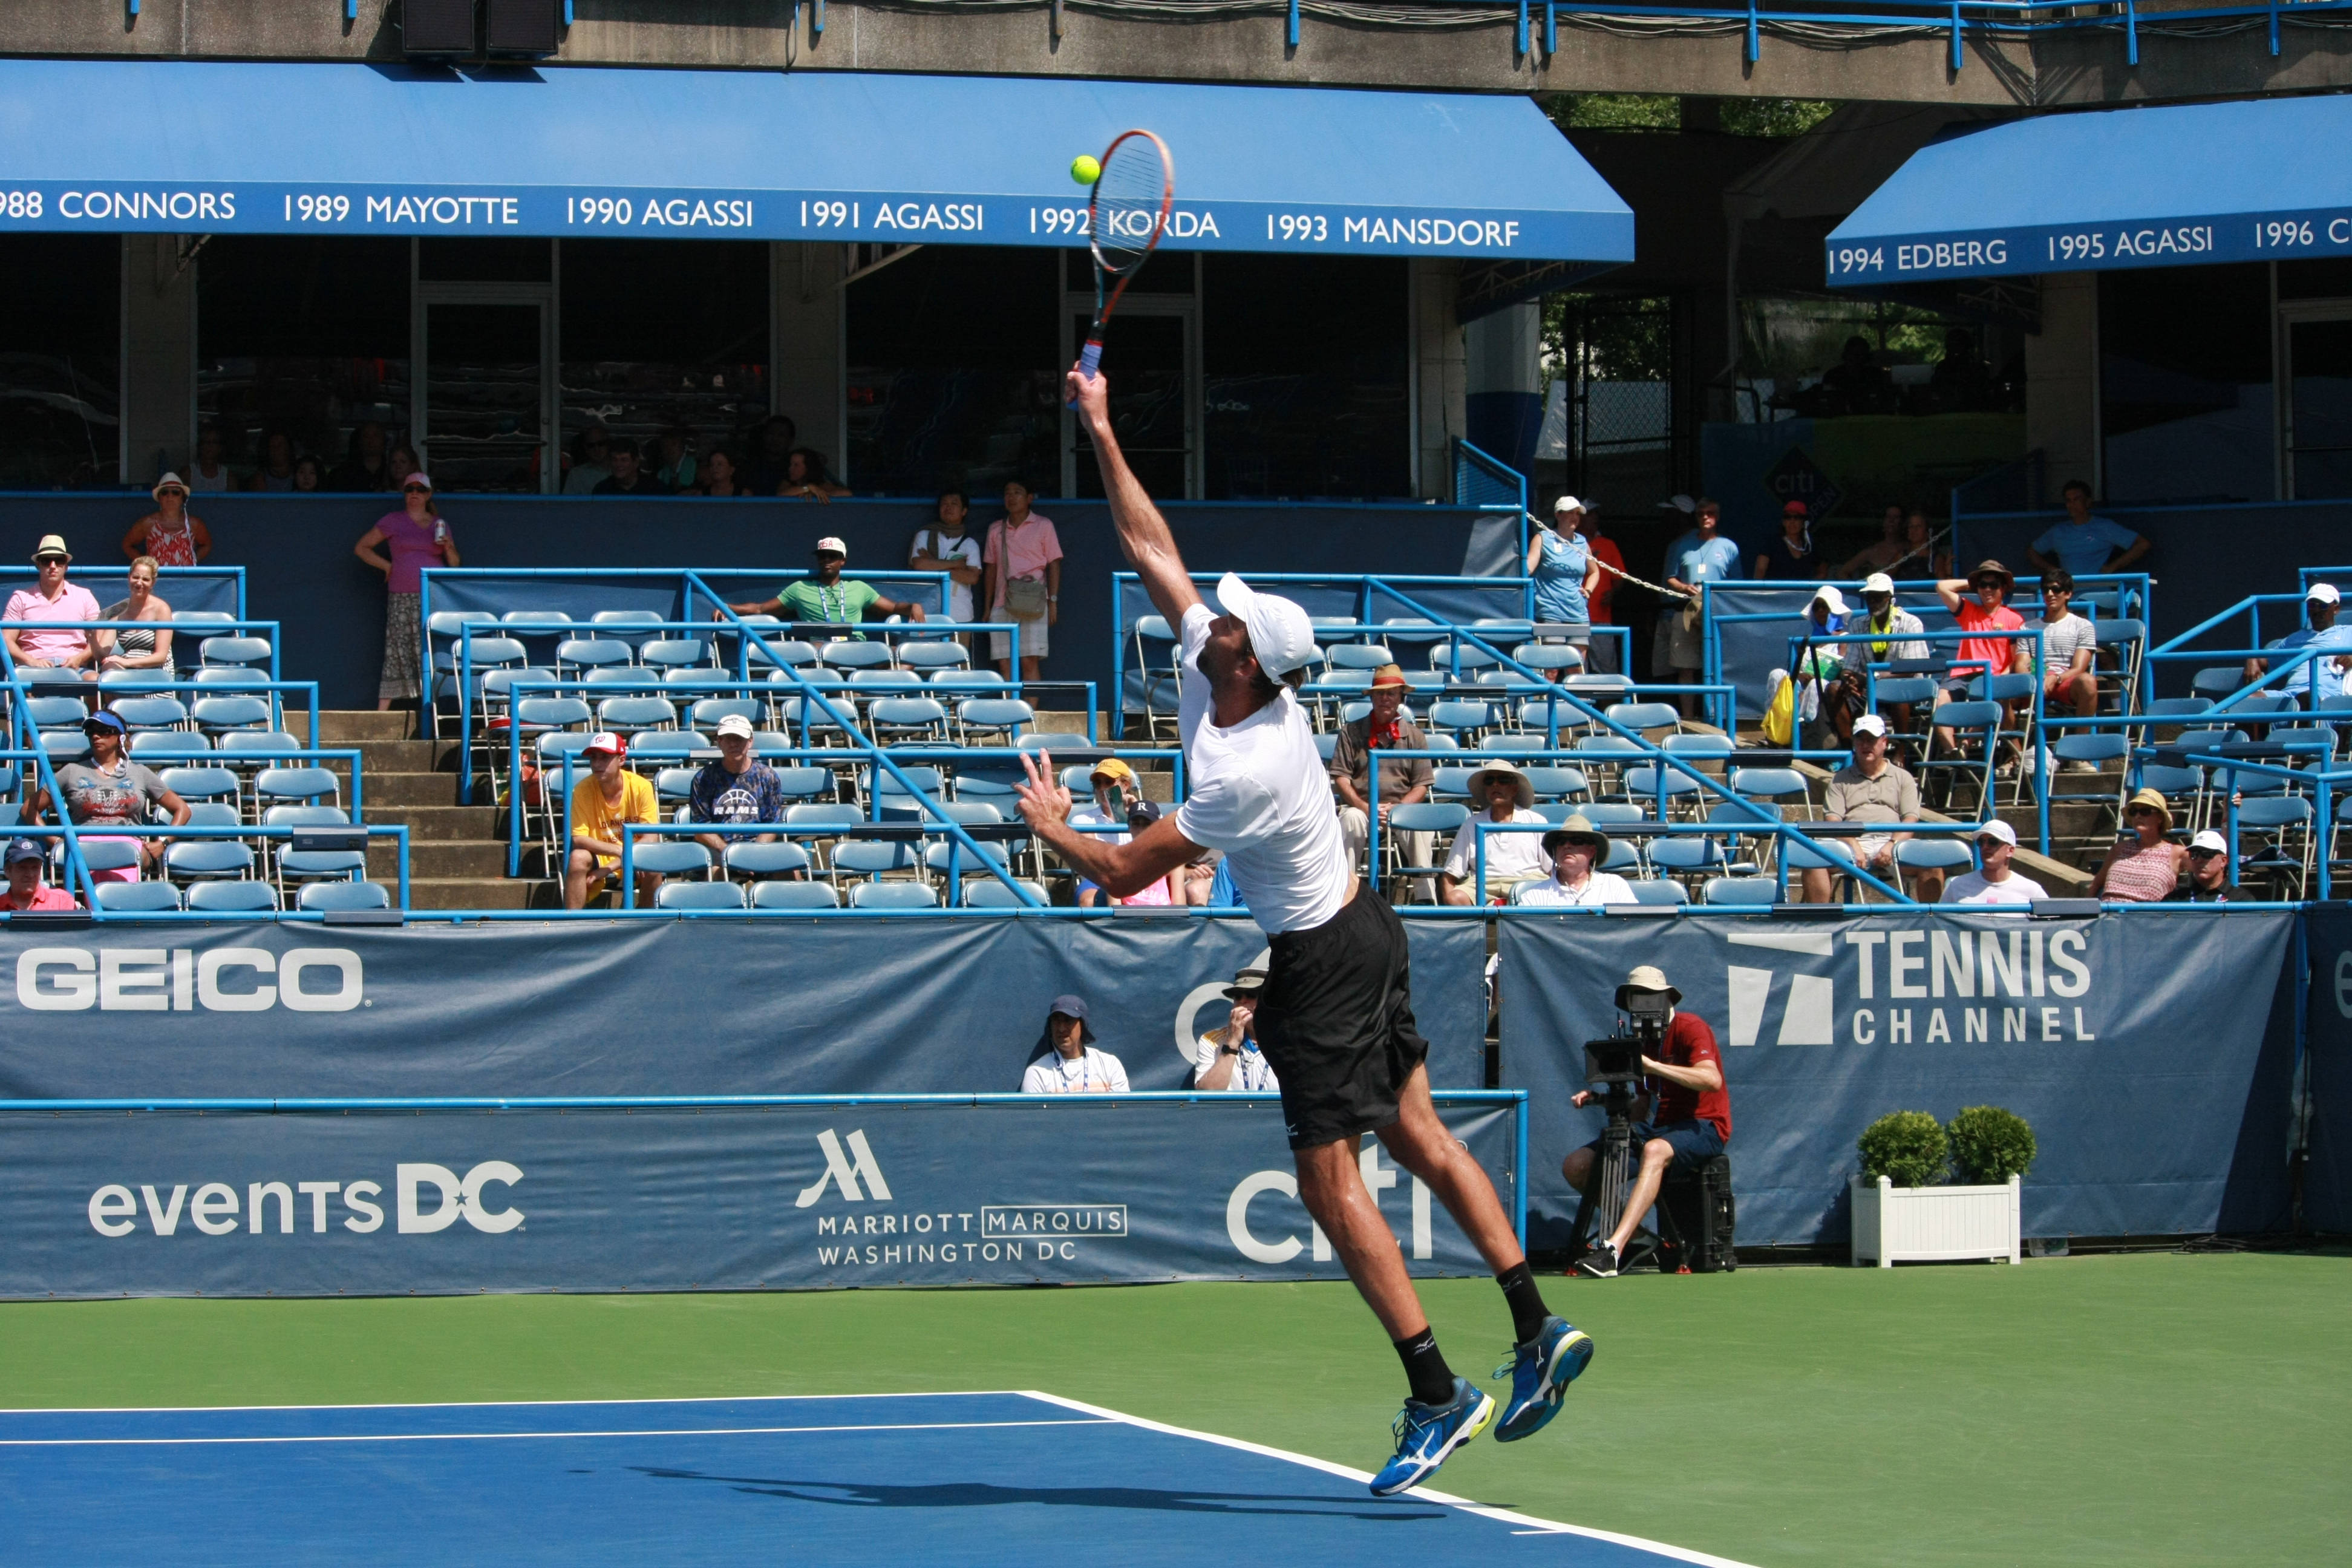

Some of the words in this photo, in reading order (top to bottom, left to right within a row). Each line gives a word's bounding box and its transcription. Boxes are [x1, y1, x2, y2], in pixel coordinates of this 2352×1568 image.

[59, 191, 235, 219] CONNORS
[286, 194, 350, 222] 1989
[367, 197, 518, 224] MAYOTTE
[568, 197, 632, 225] 1990
[641, 200, 753, 227] AGASSI
[801, 201, 859, 228] 1991
[874, 203, 982, 230] AGASSI
[1030, 207, 1090, 235] 1992
[1108, 209, 1220, 238] KORDA
[1268, 214, 1328, 241] 1993
[1344, 217, 1519, 247] MANSDORF
[2256, 221, 2314, 247] 1996
[1829, 247, 1884, 274] 1994
[1898, 240, 2007, 270] EDBERG
[2049, 233, 2105, 261] 1995
[2114, 226, 2212, 256] AGASSI
[1774, 468, 1814, 493] citi
[714, 806, 759, 815] RAMS
[1137, 802, 1148, 811] R
[17, 947, 363, 1011] GEICO
[1846, 929, 2091, 999] TENNIS
[1853, 1006, 2096, 1045] CHANNEL
[818, 1213, 973, 1235] MARRIOTT
[988, 1211, 1121, 1232] MARQUIS
[817, 1243, 1022, 1266] WASHINGTON
[1038, 1241, 1076, 1261] DC
